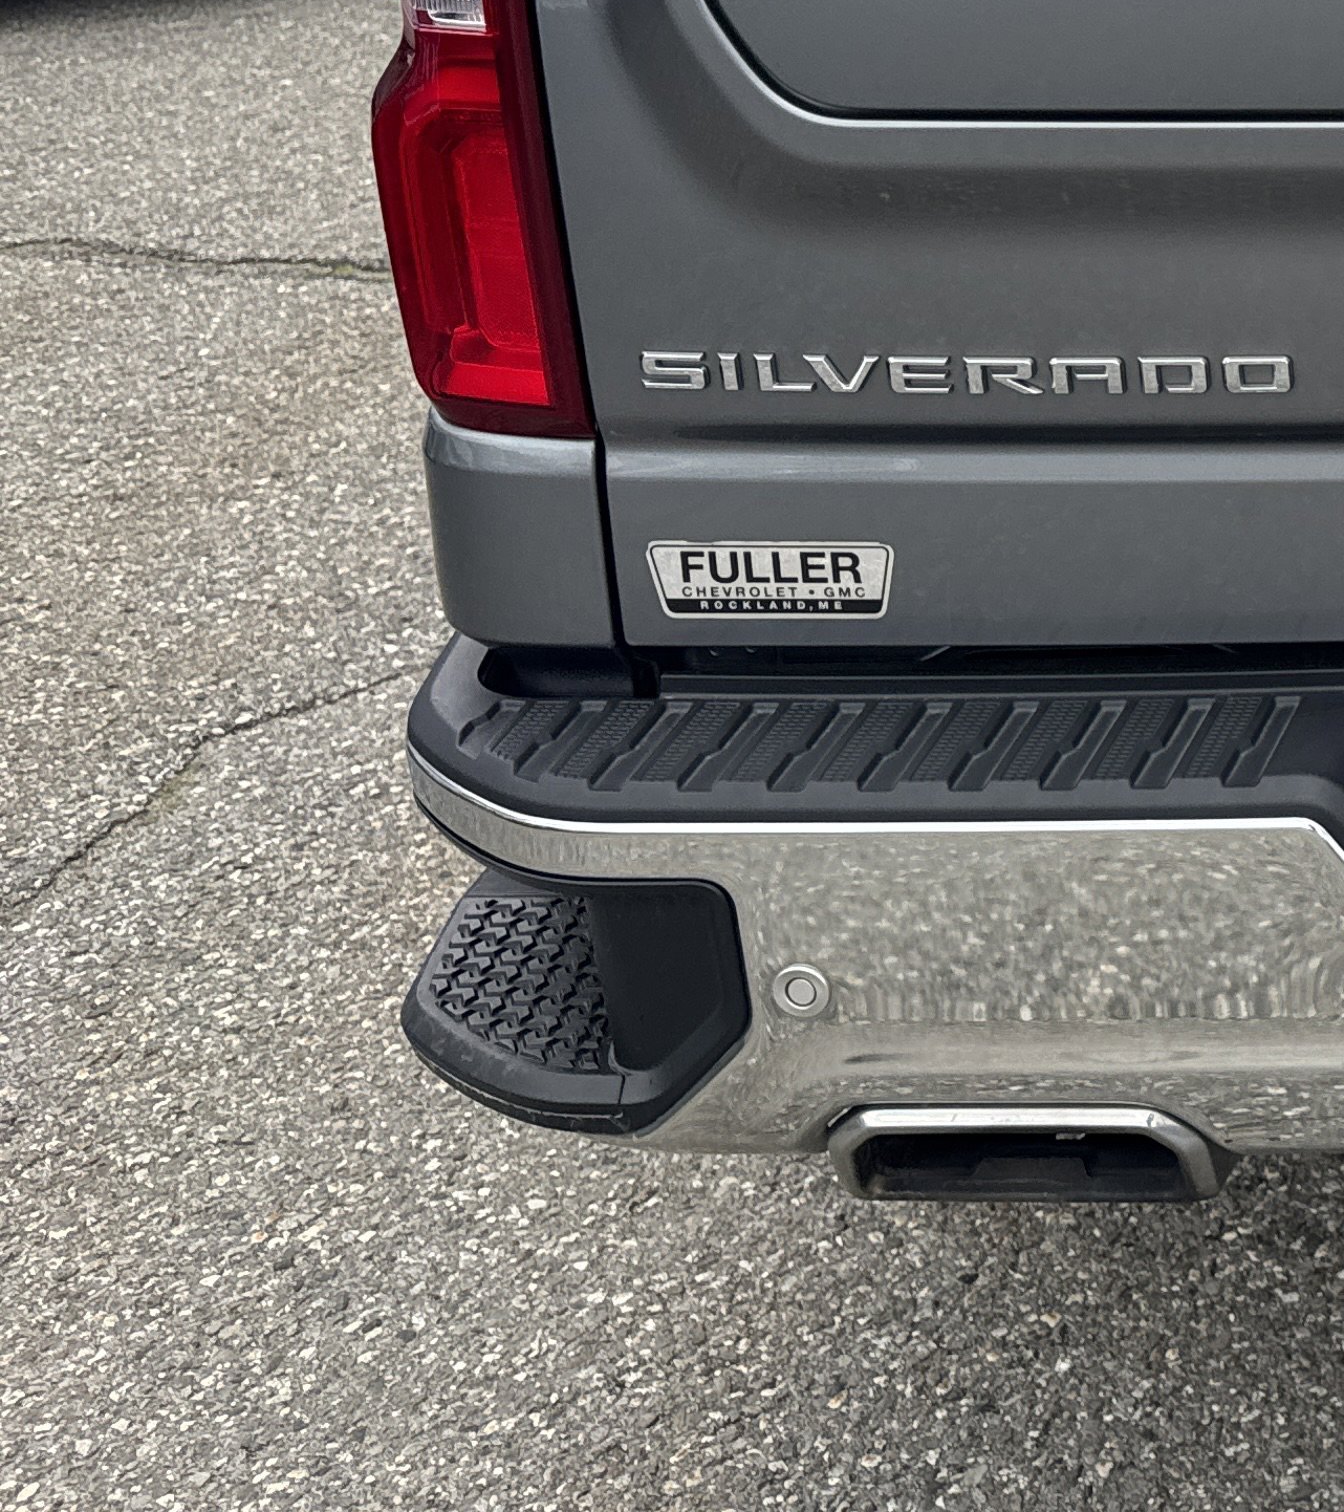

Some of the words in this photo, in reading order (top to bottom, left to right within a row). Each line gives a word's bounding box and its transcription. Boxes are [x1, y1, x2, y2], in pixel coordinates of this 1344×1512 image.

[640, 350, 1295, 395] SILVERADO
[680, 551, 863, 584] FULLER
[682, 586, 798, 598] CHEVROLET
[823, 586, 866, 598] GMC
